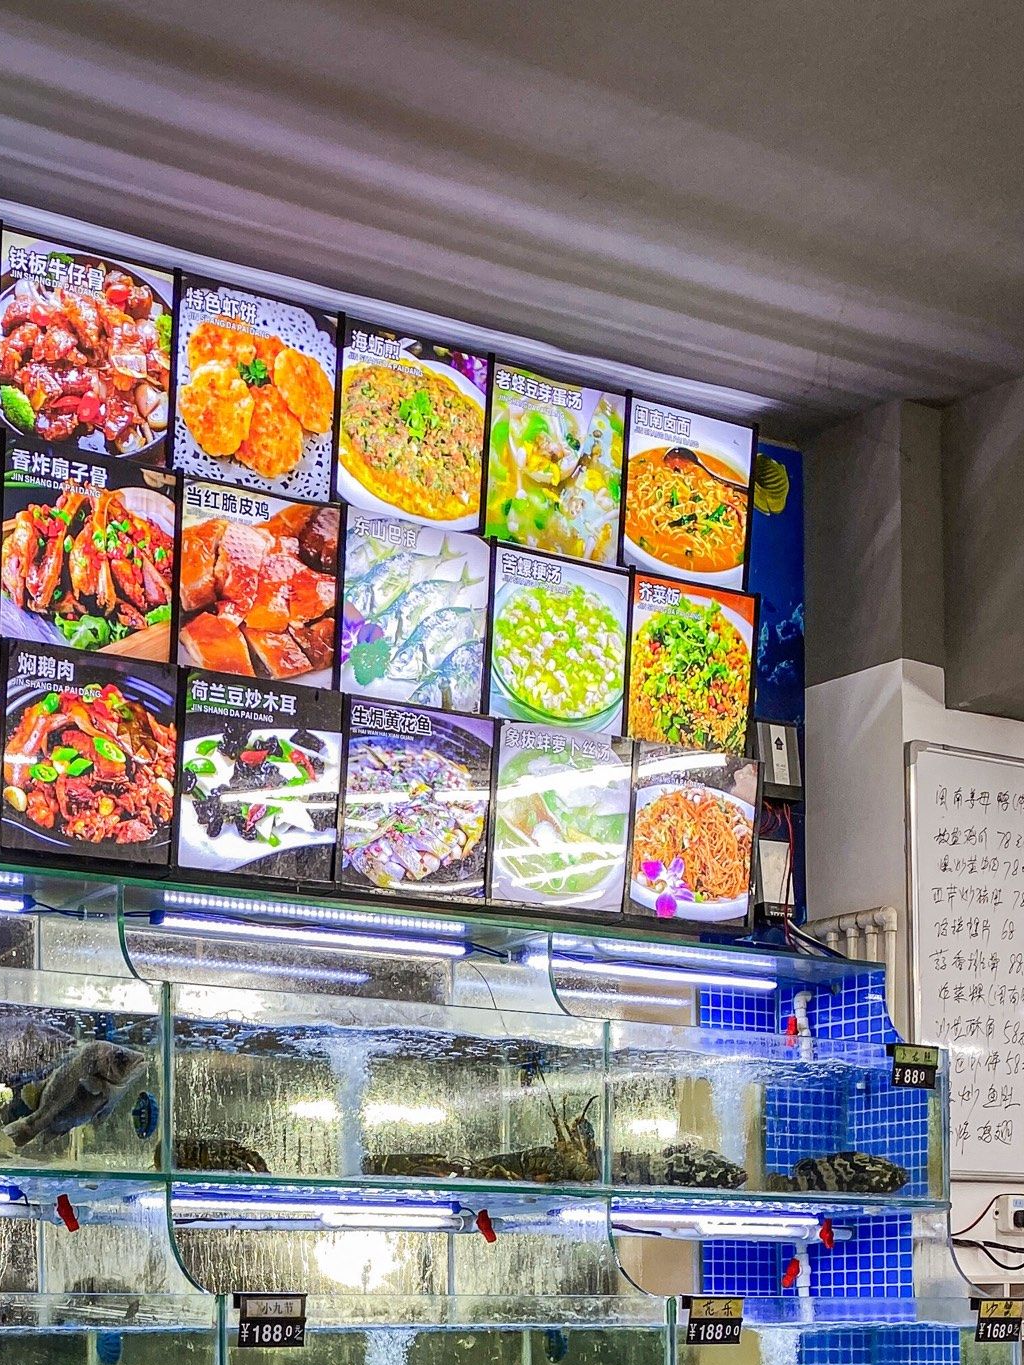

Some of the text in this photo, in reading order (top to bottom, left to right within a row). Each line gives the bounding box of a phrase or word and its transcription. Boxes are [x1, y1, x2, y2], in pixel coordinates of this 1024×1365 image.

[9, 245, 104, 291] 铁板牛仔骨
[10, 270, 22, 279] JIN
[186, 286, 257, 325] 特色虾饼
[351, 329, 401, 360] 海蛎煎
[635, 405, 691, 437] 闽南卤面
[11, 448, 108, 489] 香炸扇子骨
[11, 472, 23, 482] JIN
[25, 475, 52, 488] SHANG
[53, 481, 64, 490] DA
[186, 486, 270, 520] 当红脆皮鸡
[355, 516, 416, 548] 东山巴浪
[639, 581, 680, 607] 芥菜饭
[18, 652, 75, 682] 焖鹅肉
[25, 680, 52, 691] SHANG
[53, 684, 64, 692] DA
[65, 685, 77, 694] PAI
[78, 688, 101, 698] DANG
[191, 680, 297, 716] 荷兰豆炒木耳
[204, 705, 228, 716] SHANG
[230, 710, 240, 718] DA
[240, 711, 252, 720] PAI
[254, 713, 274, 723] DANG
[351, 705, 432, 736] 生焗黄花鱼
[505, 727, 611, 761] 象拔蚌萝卜丝汤
[689, 1324, 739, 1340] ¥188.00
